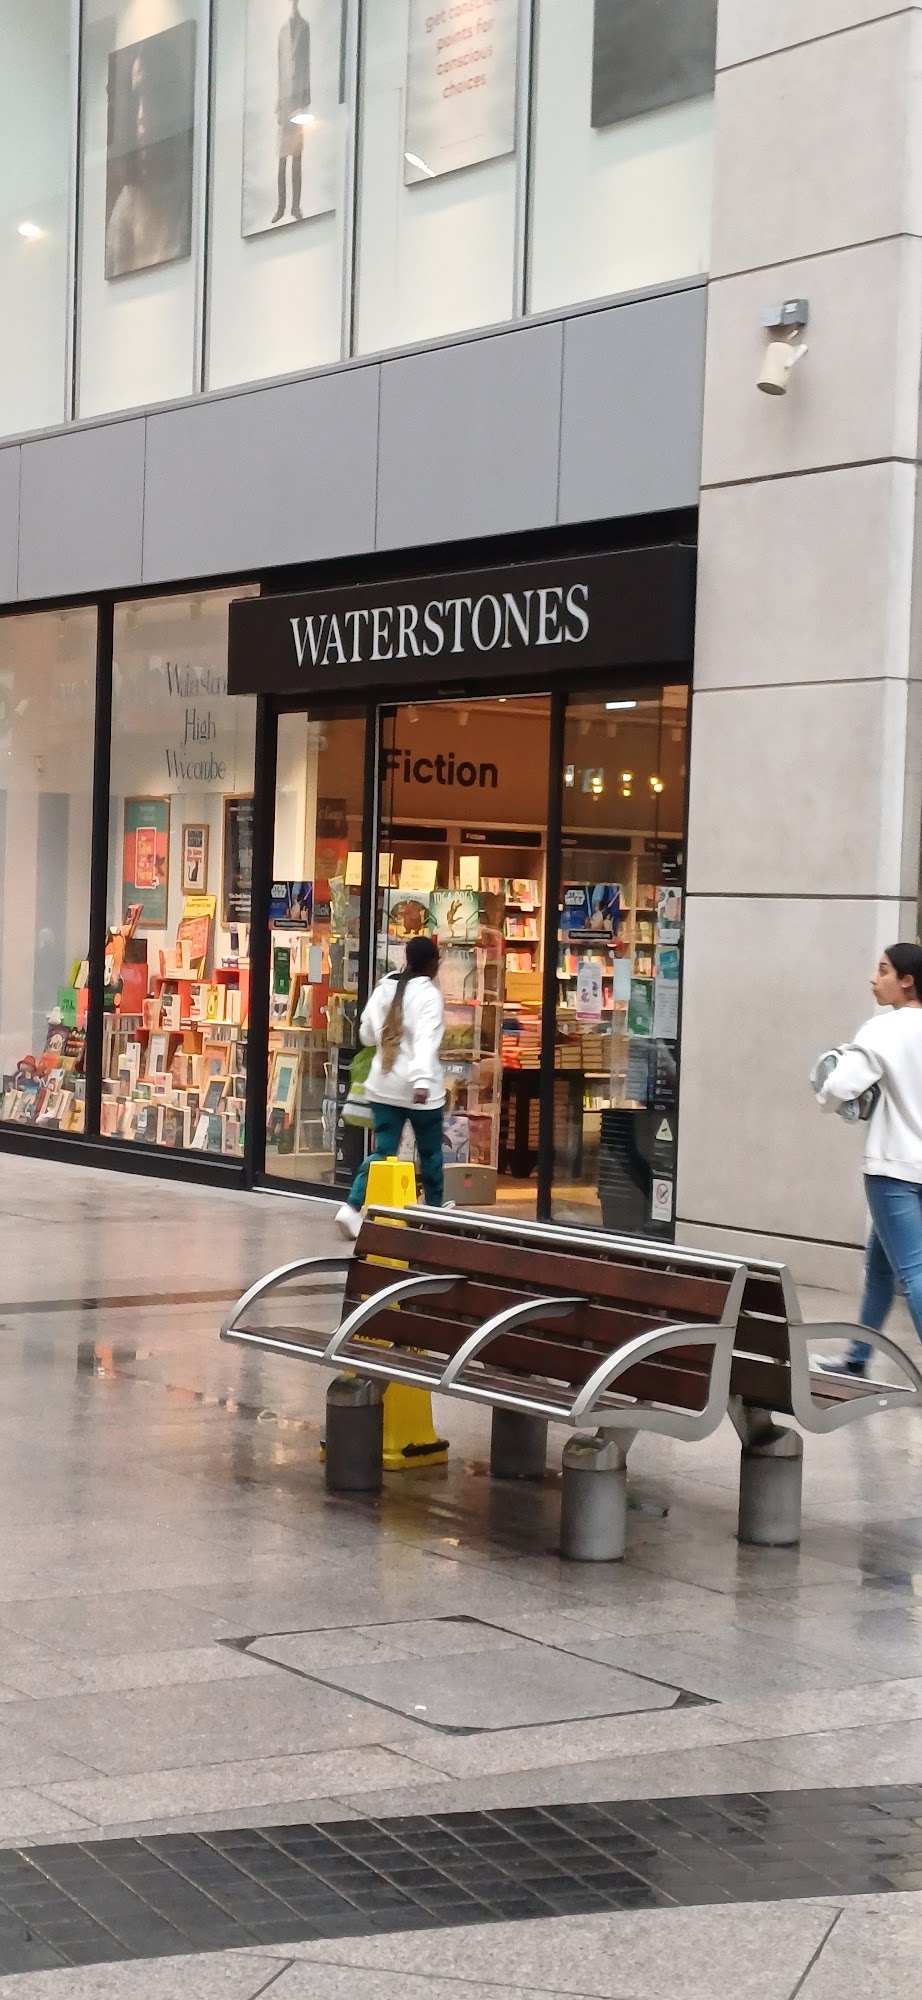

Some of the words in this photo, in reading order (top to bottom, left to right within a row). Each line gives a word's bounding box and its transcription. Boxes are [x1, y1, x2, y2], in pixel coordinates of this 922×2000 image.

[442, 74, 486, 98] choices
[289, 583, 590, 668] WATERSTONES
[180, 708, 216, 747] High
[165, 748, 226, 786] Wycombe
[379, 748, 499, 788] Fiction
